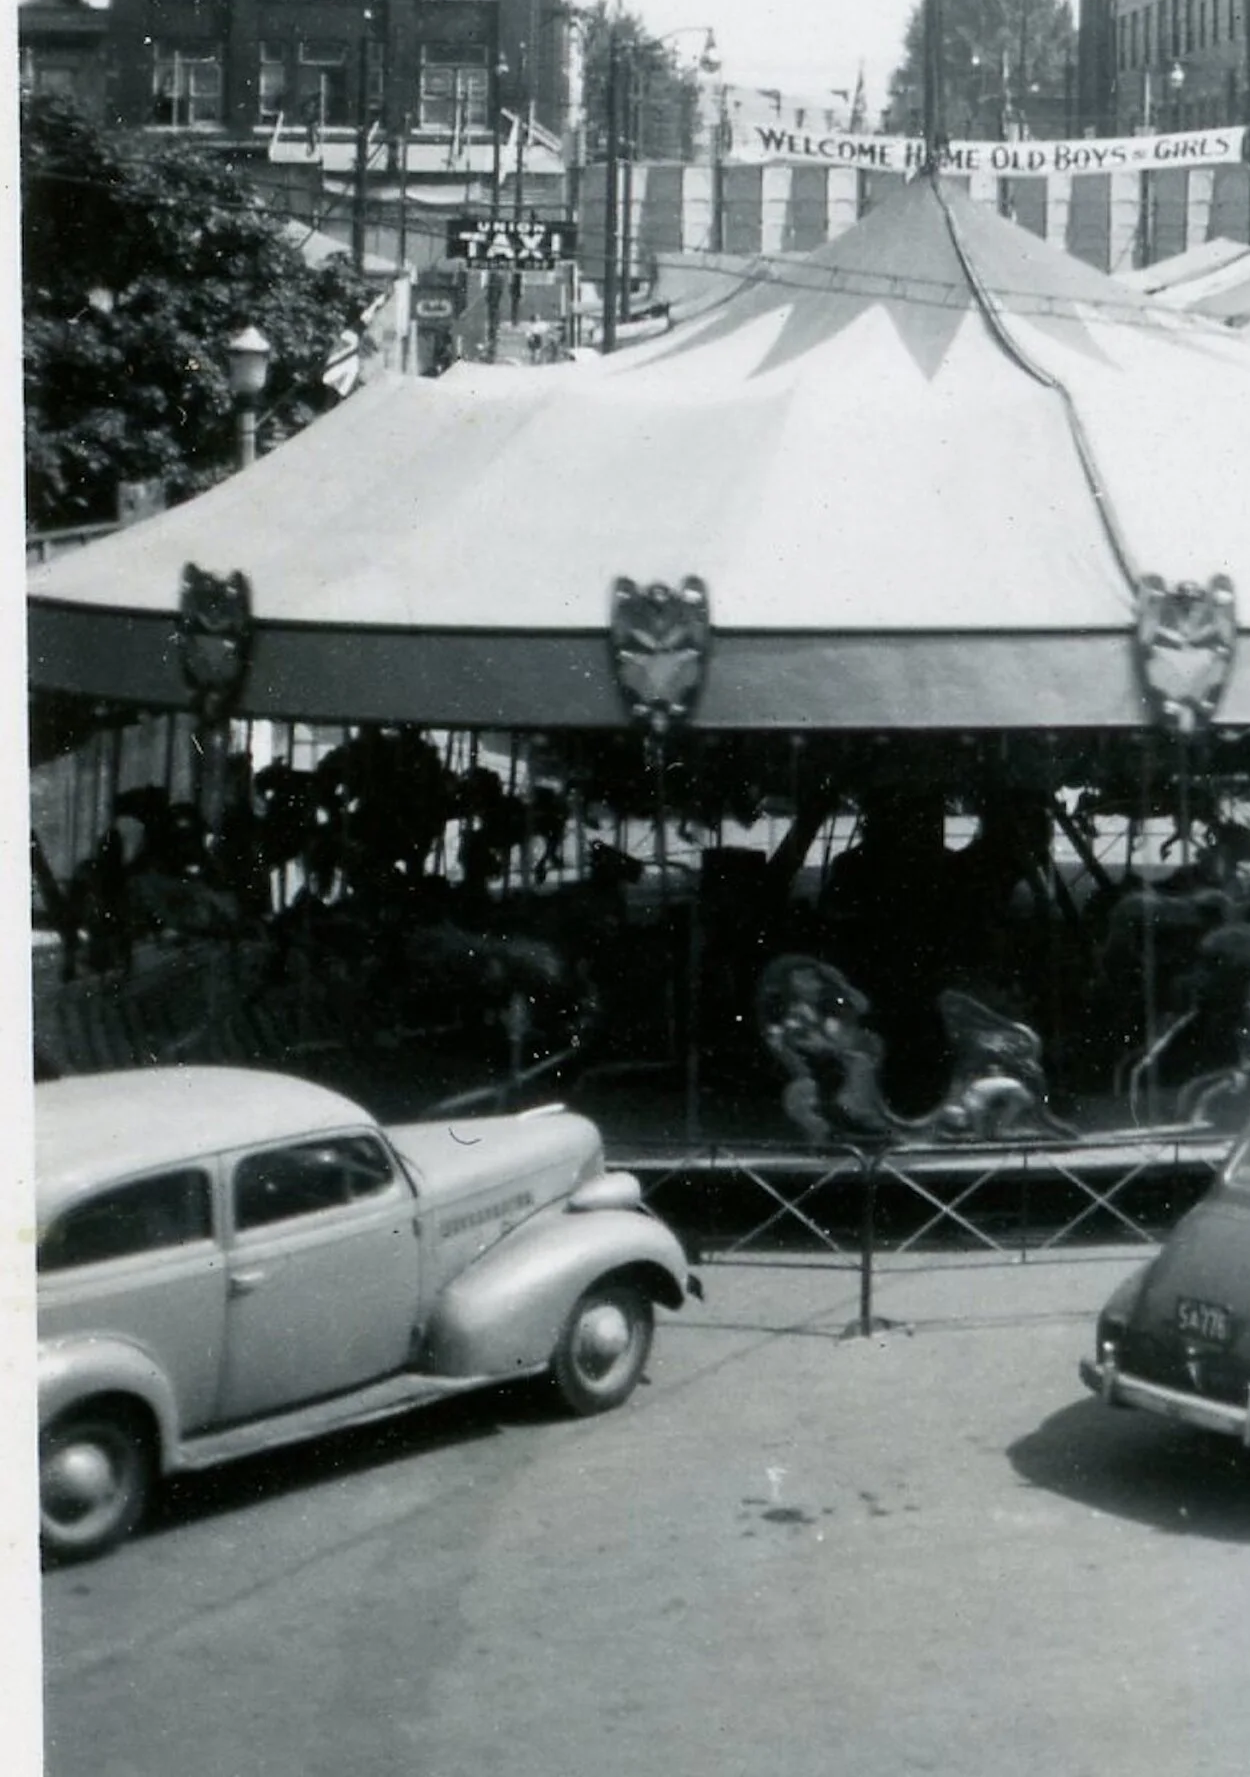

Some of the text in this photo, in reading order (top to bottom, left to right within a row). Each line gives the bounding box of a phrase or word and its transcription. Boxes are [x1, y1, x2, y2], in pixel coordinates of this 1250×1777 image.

[756, 126, 894, 167] WELCOME
[905, 141, 980, 169] HME
[991, 145, 1046, 171] OLD
[1054, 144, 1128, 171] BOYS
[1153, 137, 1231, 160] GIRLS
[477, 221, 546, 233] UNION
[459, 231, 561, 259] TAXI
